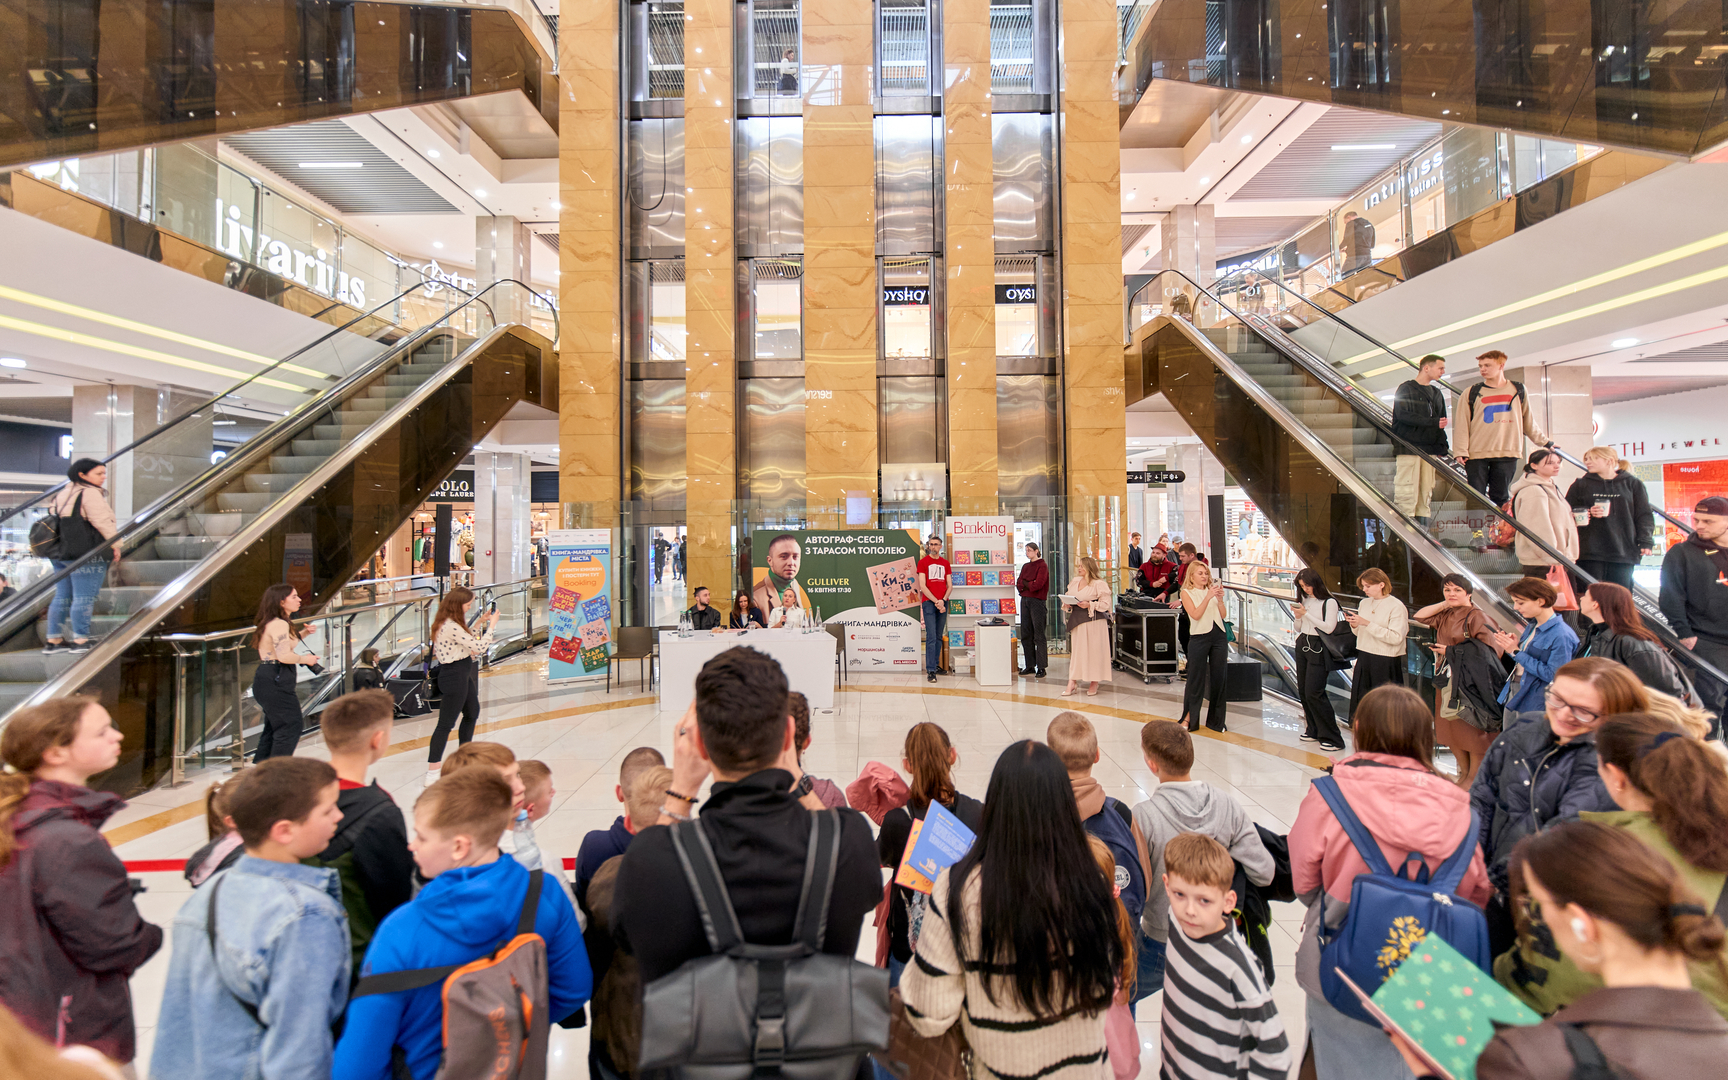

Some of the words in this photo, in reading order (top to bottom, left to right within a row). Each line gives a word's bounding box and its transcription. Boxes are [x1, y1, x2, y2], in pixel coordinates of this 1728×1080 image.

[805, 535, 884, 544] АВТОГРАФ-СЕСІЯ
[812, 547, 856, 555] ТАРАСОМ
[858, 547, 906, 555] ТОПОЛЕЮ
[807, 578, 849, 586] GULLIVER
